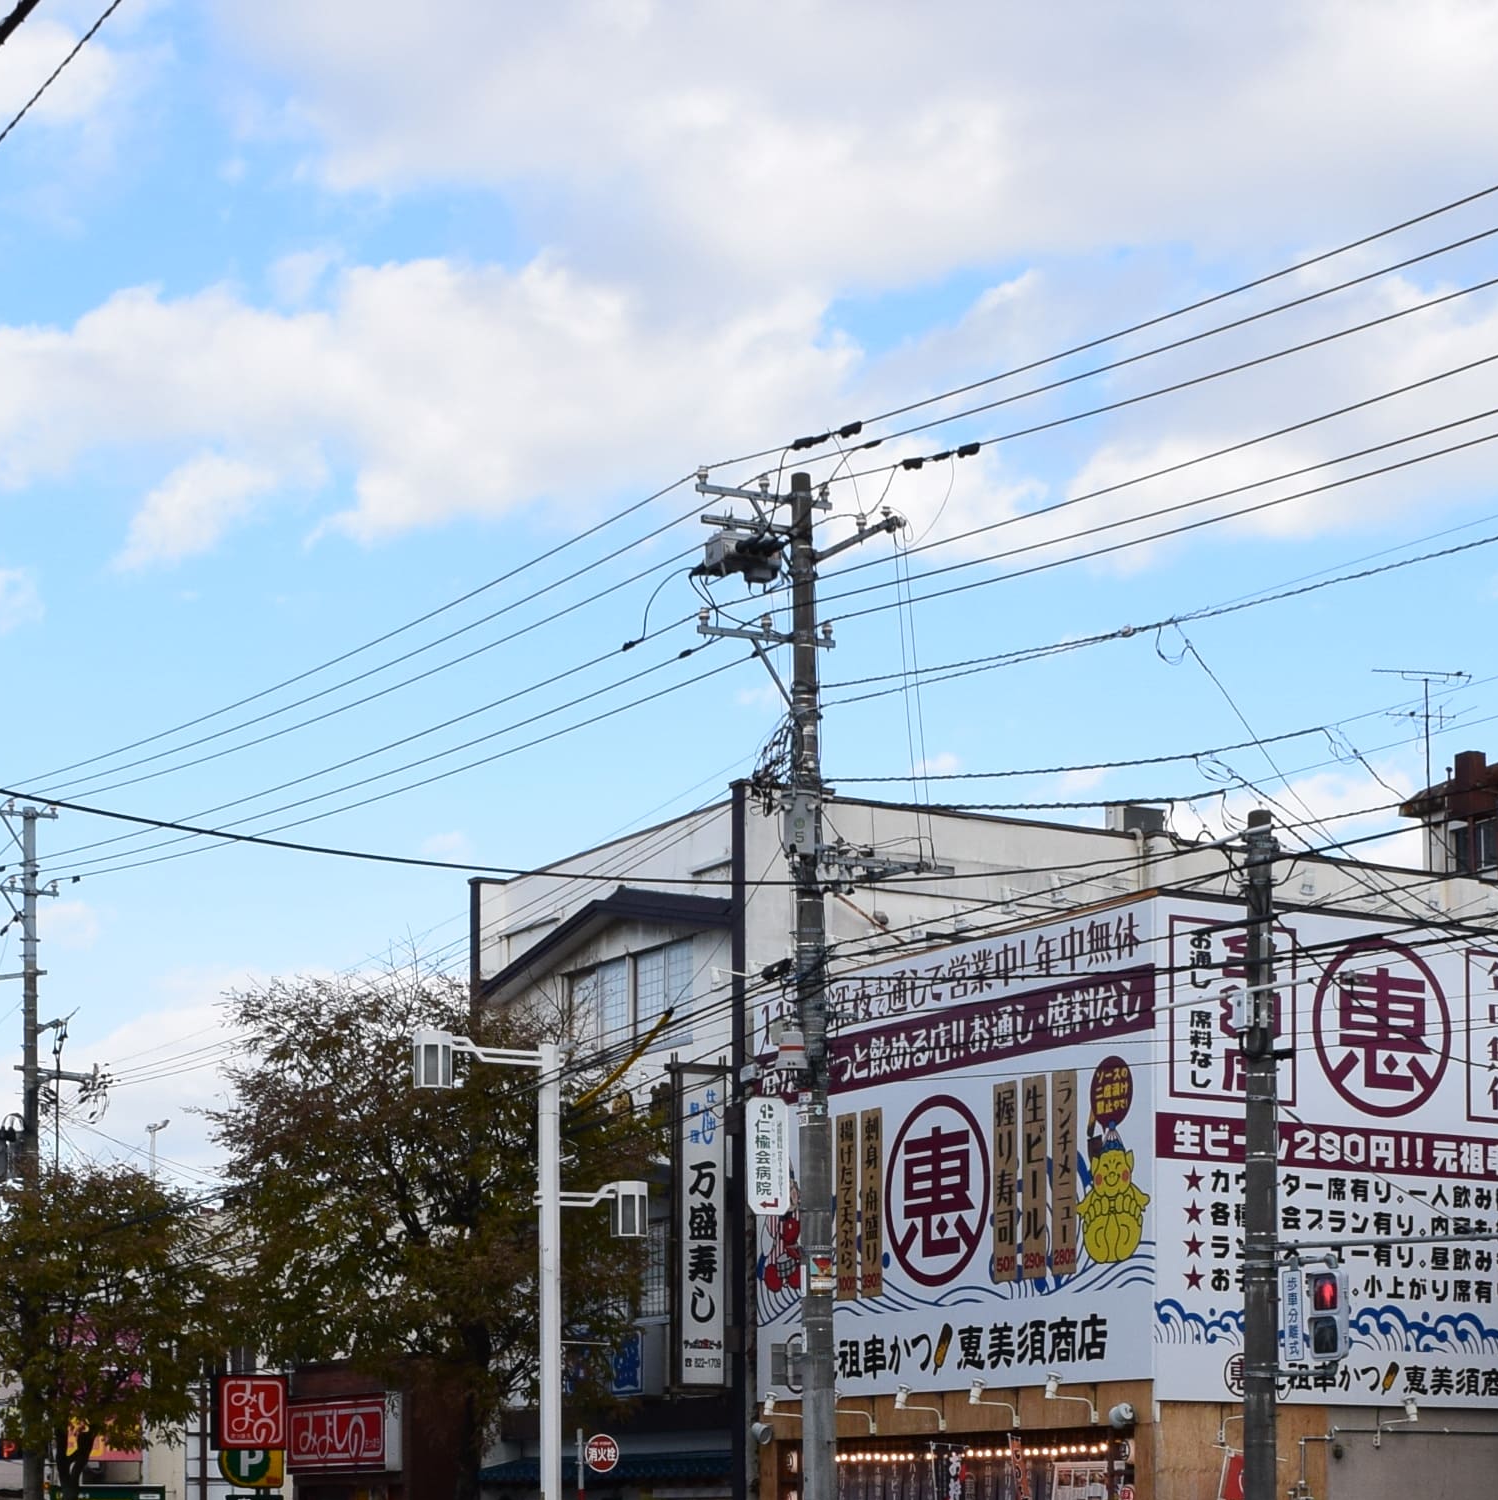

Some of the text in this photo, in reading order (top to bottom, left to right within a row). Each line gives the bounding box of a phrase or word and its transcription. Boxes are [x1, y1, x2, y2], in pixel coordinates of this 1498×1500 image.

[839, 1120, 854, 1270] 揚げたて天ぷら
[995, 1089, 1017, 1247] 握り寿司
[1024, 1084, 1045, 1241] 生ビール
[1057, 1080, 1074, 1245] ランチメニュー
[688, 1161, 718, 1324] 万盛寿し
[299, 1410, 366, 1459] みよしの
[588, 1447, 617, 1462] 消火栓
